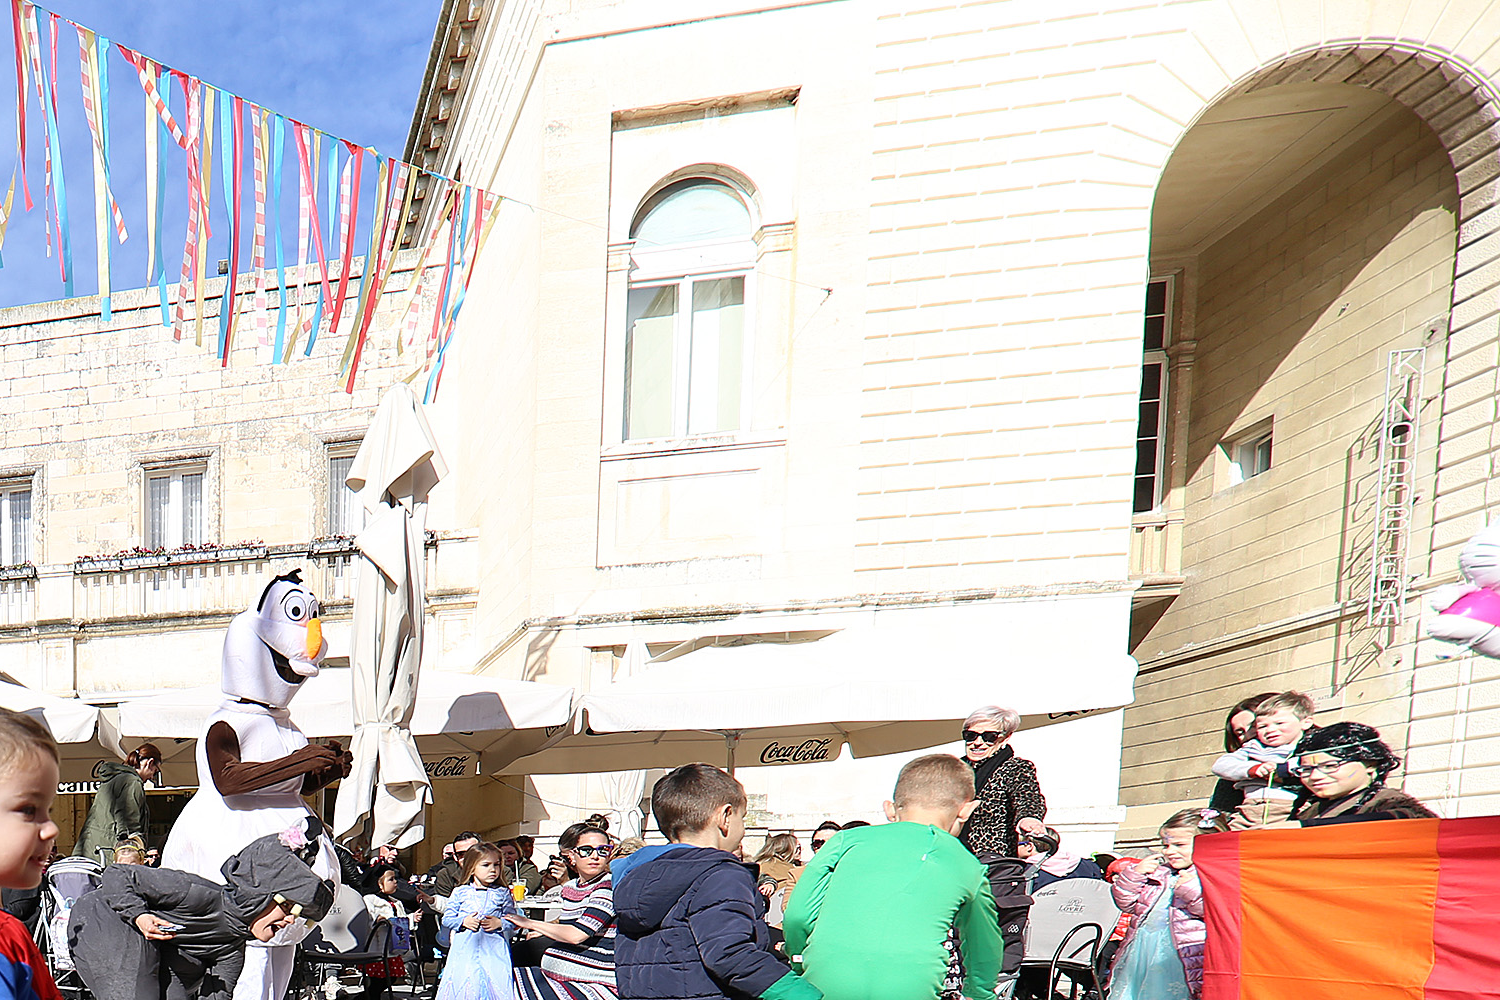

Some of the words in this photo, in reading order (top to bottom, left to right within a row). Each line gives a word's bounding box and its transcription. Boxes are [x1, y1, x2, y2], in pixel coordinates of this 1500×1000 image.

[1388, 350, 1419, 447] KINO
[1376, 458, 1412, 626] POBJEDA
[422, 755, 471, 777] ca-Cola
[760, 738, 833, 764] Coca-Cola
